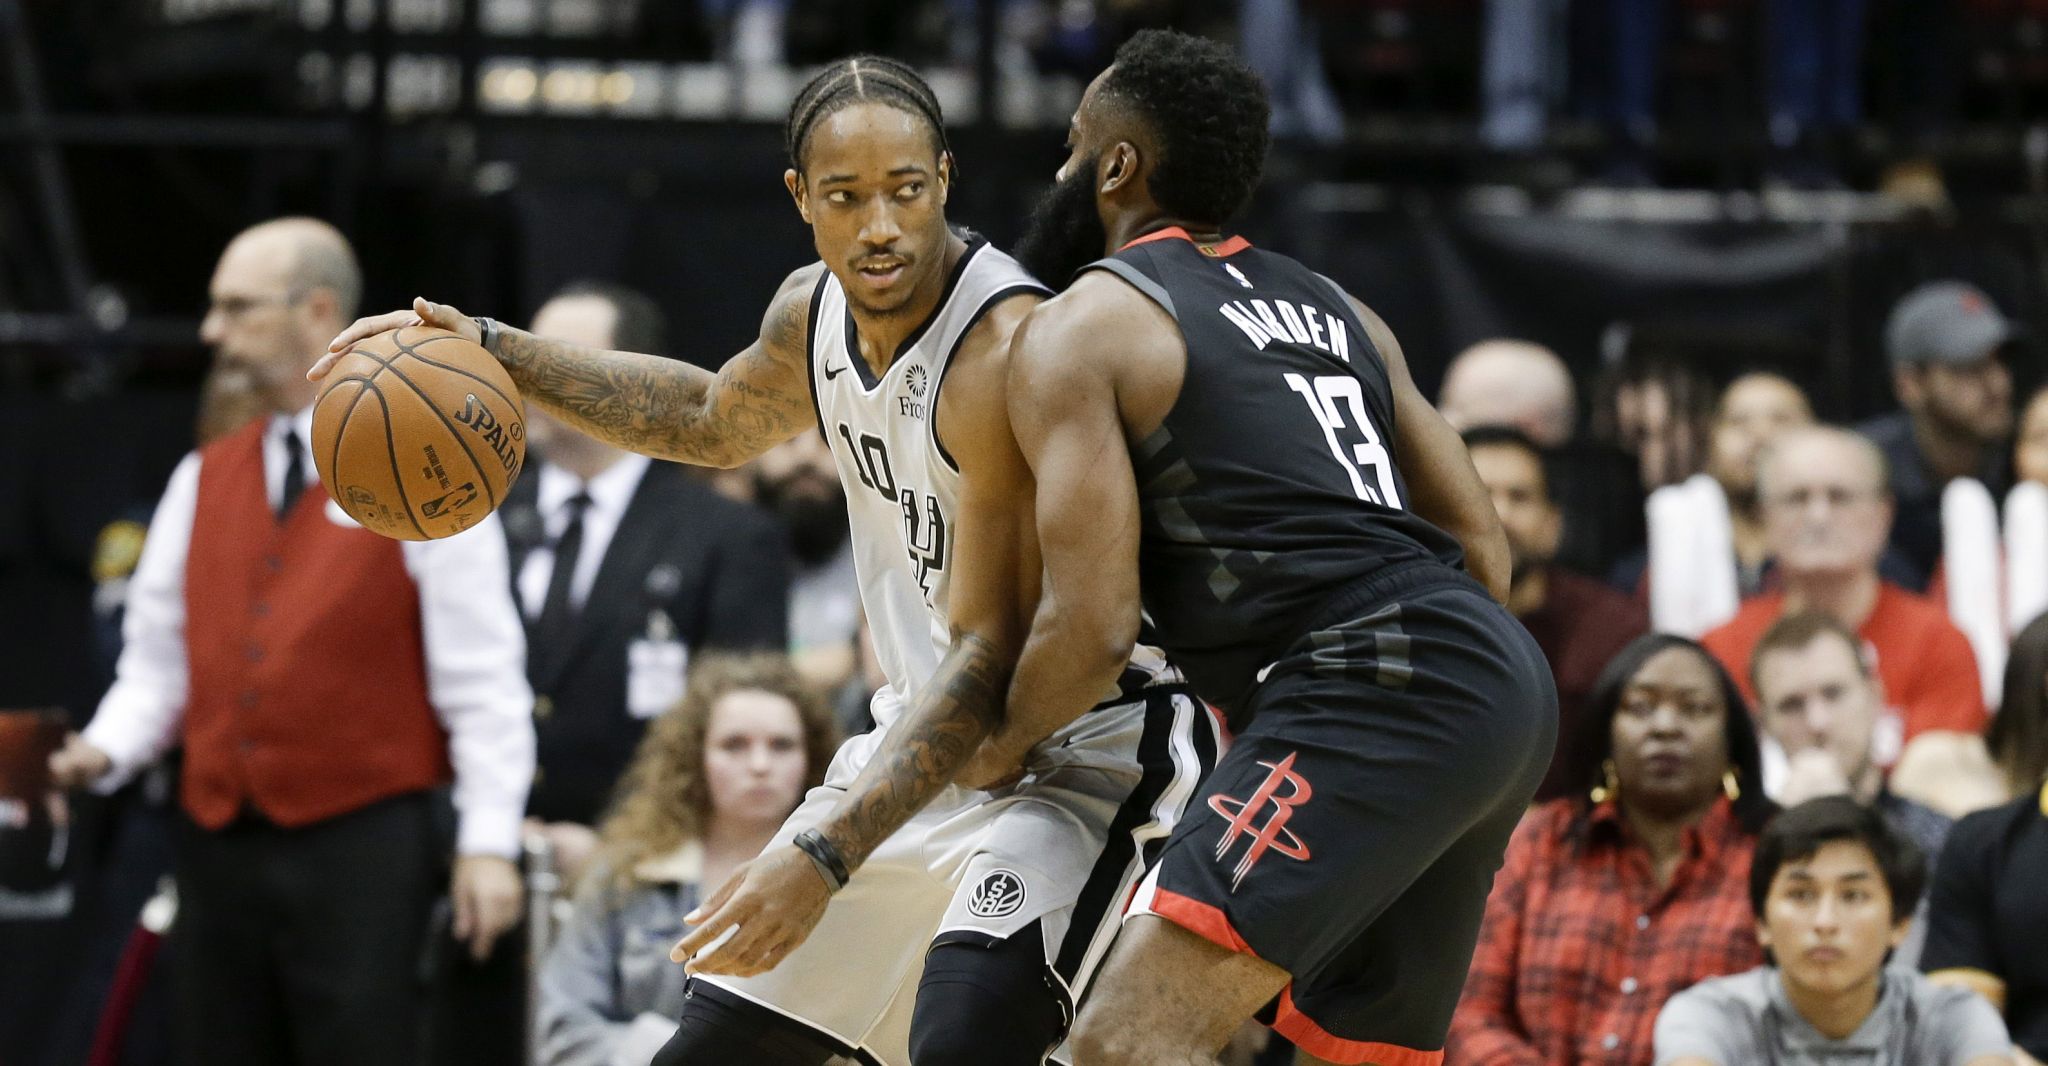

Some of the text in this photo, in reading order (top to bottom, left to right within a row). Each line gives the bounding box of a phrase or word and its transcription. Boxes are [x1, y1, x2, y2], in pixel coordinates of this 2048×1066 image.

[454, 393, 519, 488] SPALDI
[838, 422, 899, 503] 10
[1283, 373, 1403, 511] 13
